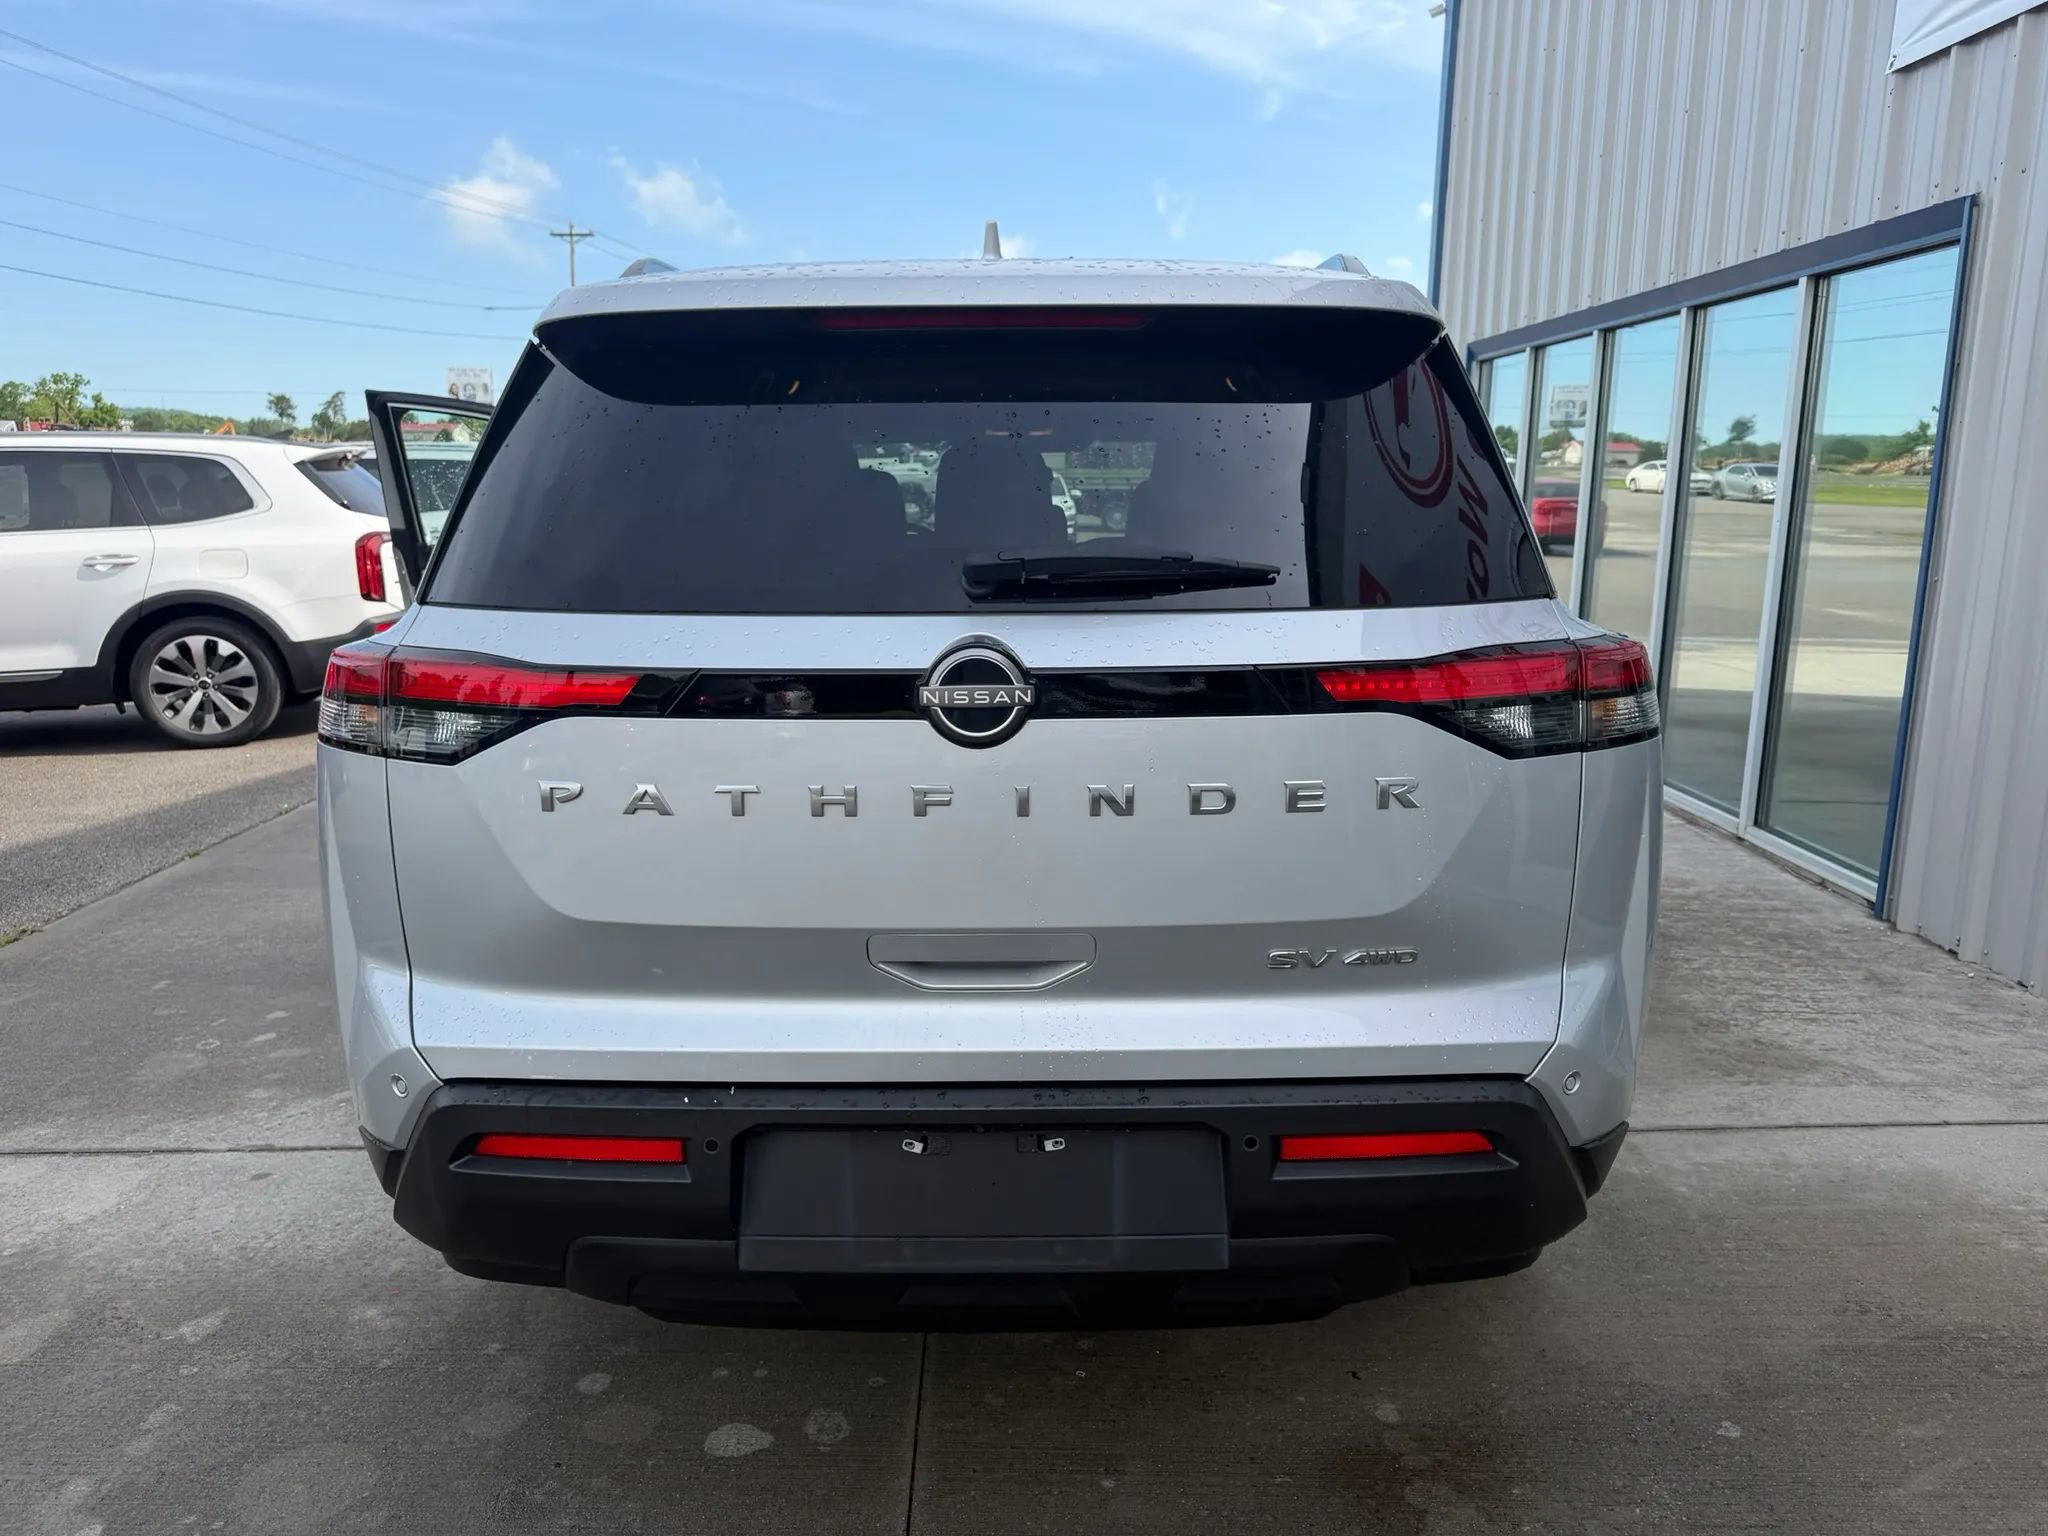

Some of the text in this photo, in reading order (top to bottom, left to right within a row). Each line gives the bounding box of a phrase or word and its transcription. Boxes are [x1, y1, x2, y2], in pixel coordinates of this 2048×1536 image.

[922, 689, 1032, 704] NISSAN
[538, 776, 1421, 817] PATHFINDER
[1266, 947, 1418, 968] SV 4WD
